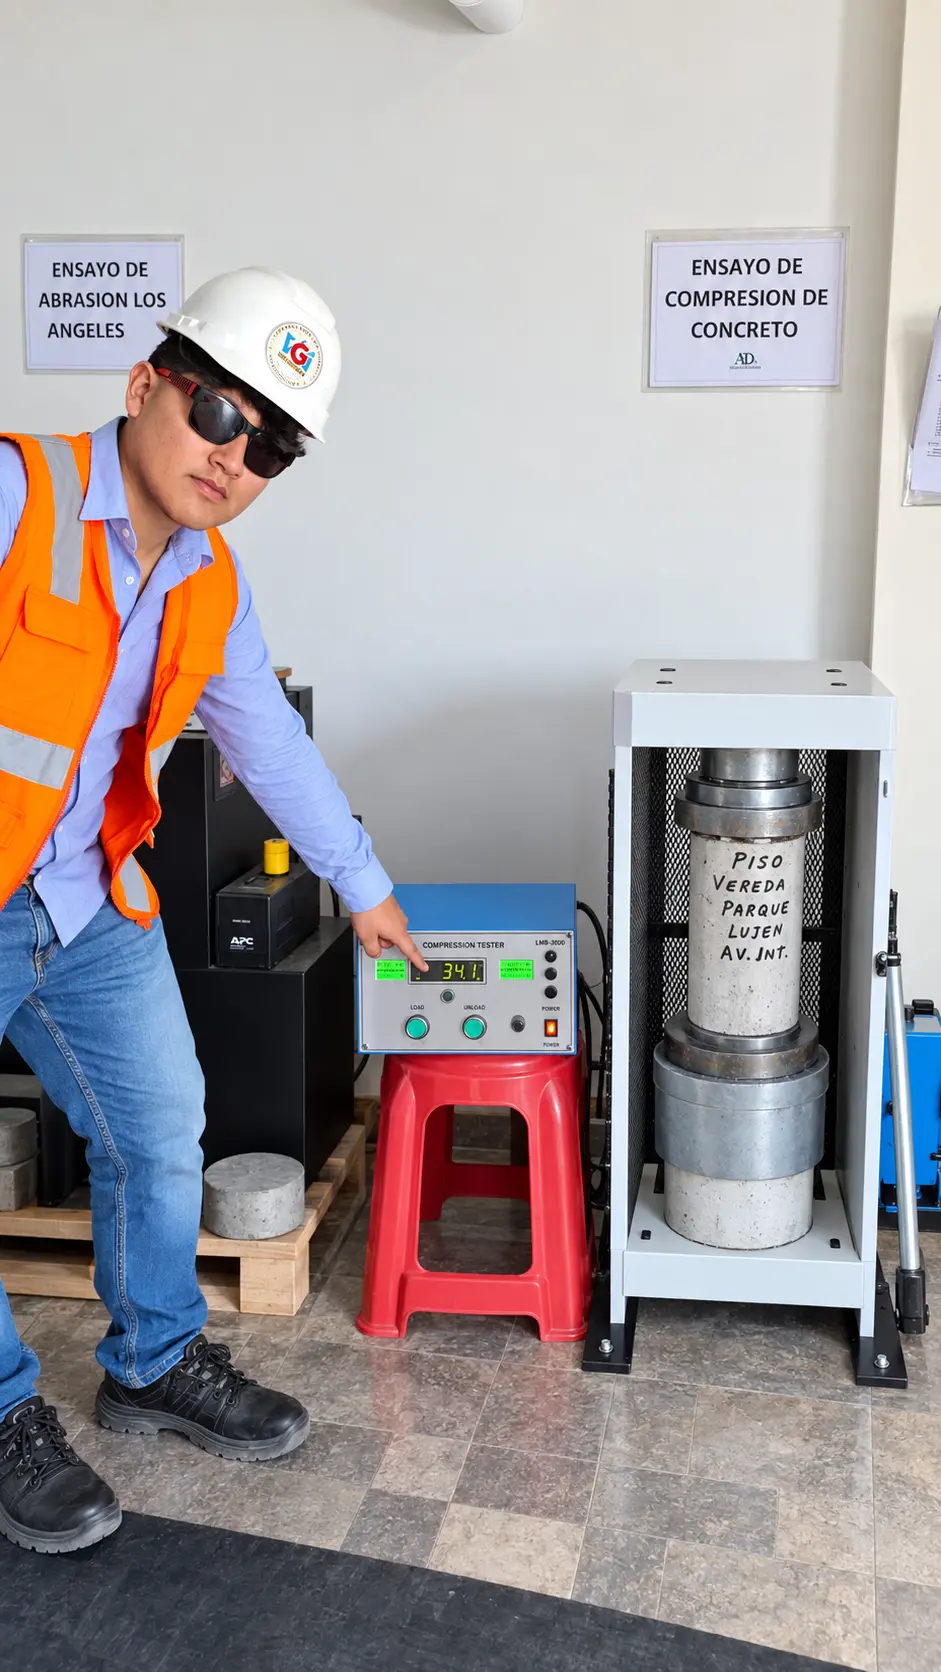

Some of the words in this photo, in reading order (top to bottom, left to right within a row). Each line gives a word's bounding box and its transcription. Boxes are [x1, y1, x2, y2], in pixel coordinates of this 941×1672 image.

[52, 261, 120, 278] ENSAYO
[126, 261, 149, 278] DE
[692, 258, 771, 276] ENSAYO
[777, 257, 803, 275] DE
[38, 291, 128, 309] ABRASION
[134, 291, 167, 309] LOS
[665, 289, 796, 307] COMPRESION
[802, 288, 829, 306] DE
[47, 322, 125, 339] ANGELES
[691, 320, 798, 339] CONCRETO
[732, 851, 783, 869] PISO
[713, 874, 785, 893] VEREDA
[721, 900, 790, 918] PARQUE
[727, 923, 783, 939] LUJEN
[230, 936, 254, 945] APC
[720, 945, 750, 961] AV.
